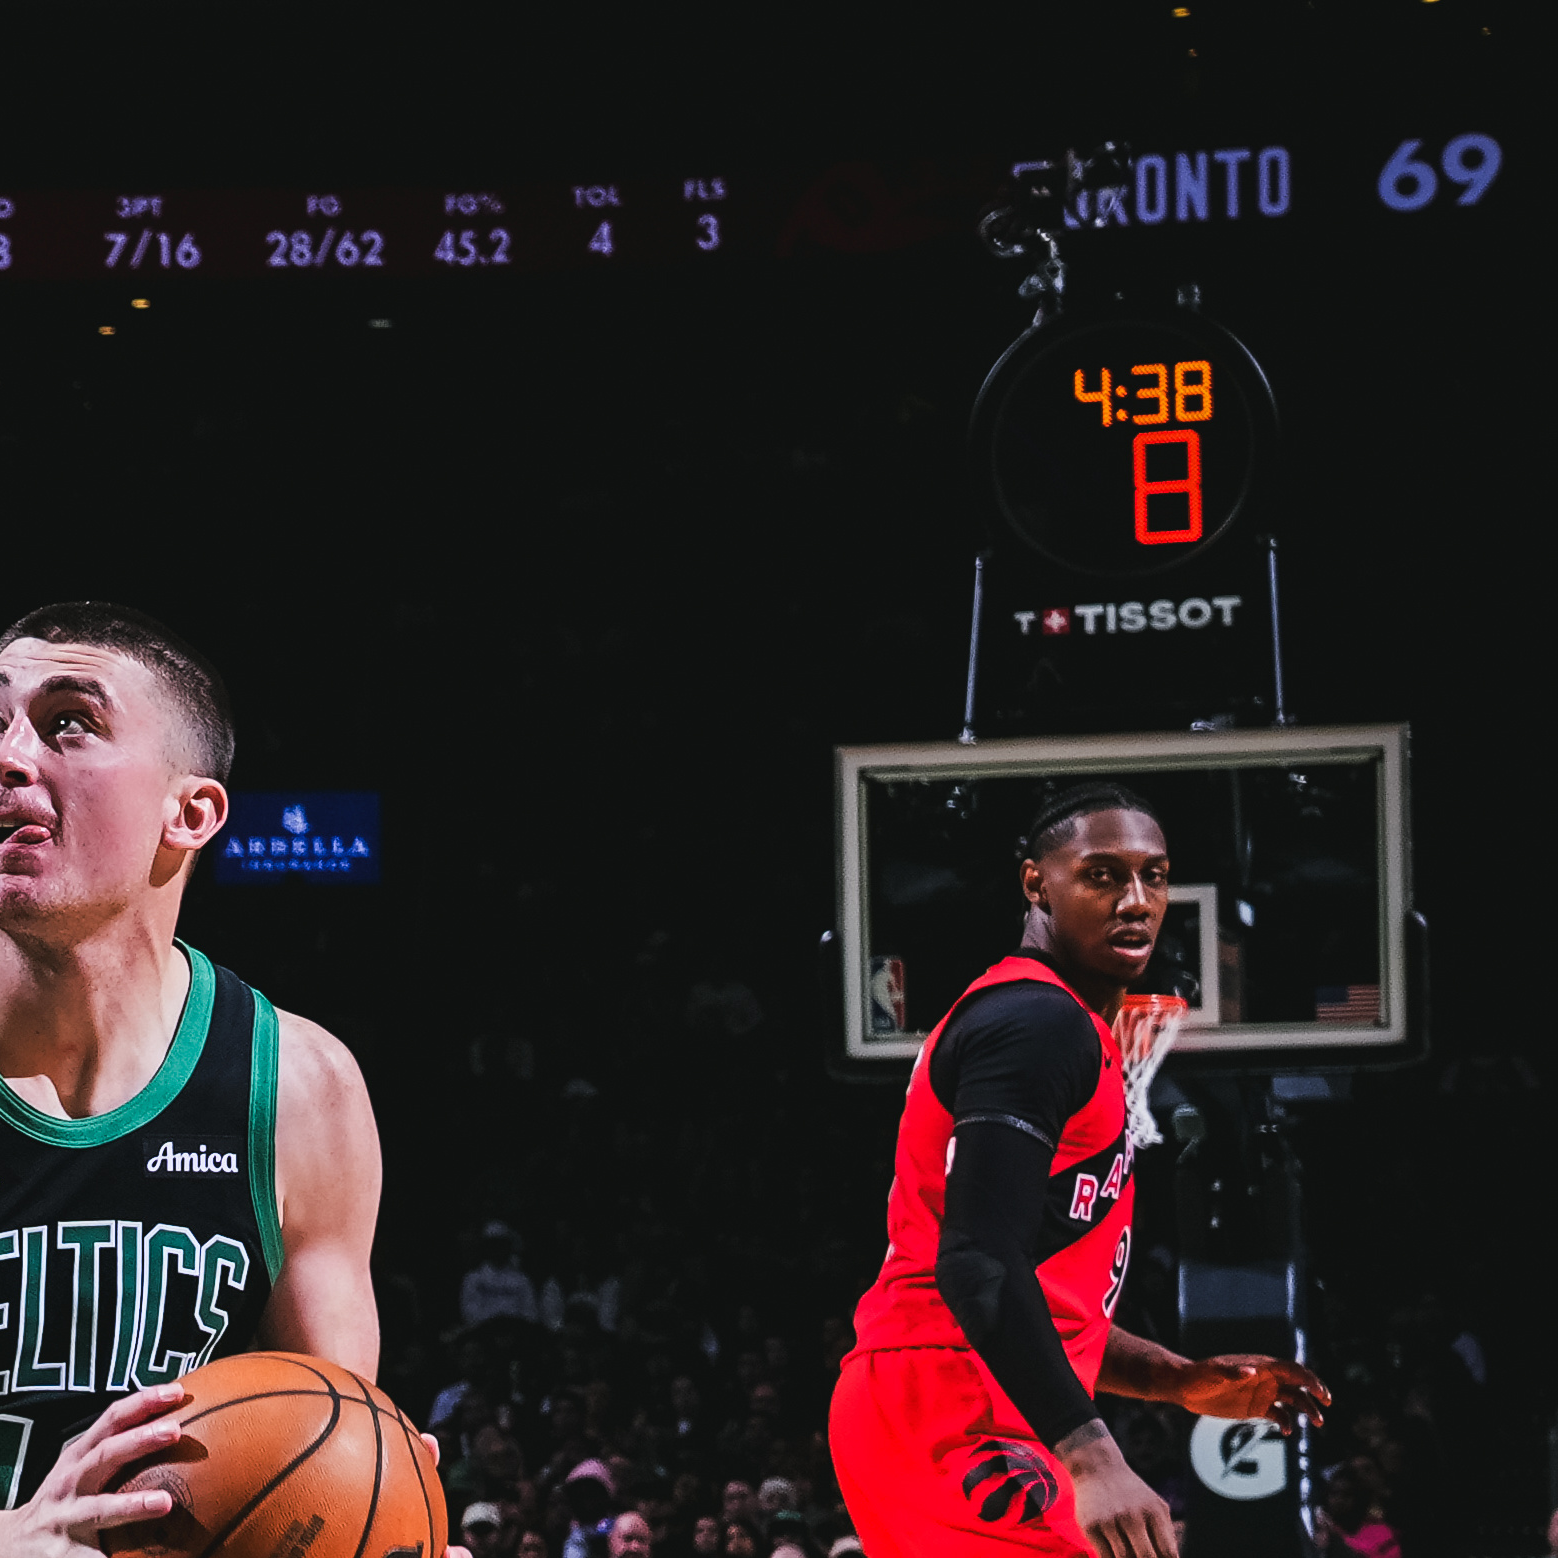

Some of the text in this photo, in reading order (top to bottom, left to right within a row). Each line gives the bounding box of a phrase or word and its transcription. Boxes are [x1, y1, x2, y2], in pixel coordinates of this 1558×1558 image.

[1378, 133, 1503, 212] 69
[104, 229, 203, 270] 7/16
[265, 227, 385, 268] 28/62
[434, 228, 512, 267] 45.2
[589, 220, 615, 256] 4
[696, 213, 722, 252] 3
[1074, 360, 1214, 427] 4:38
[1132, 429, 1204, 546] 8
[1074, 595, 1243, 636] TISSOT
[146, 1140, 239, 1174] Amica
